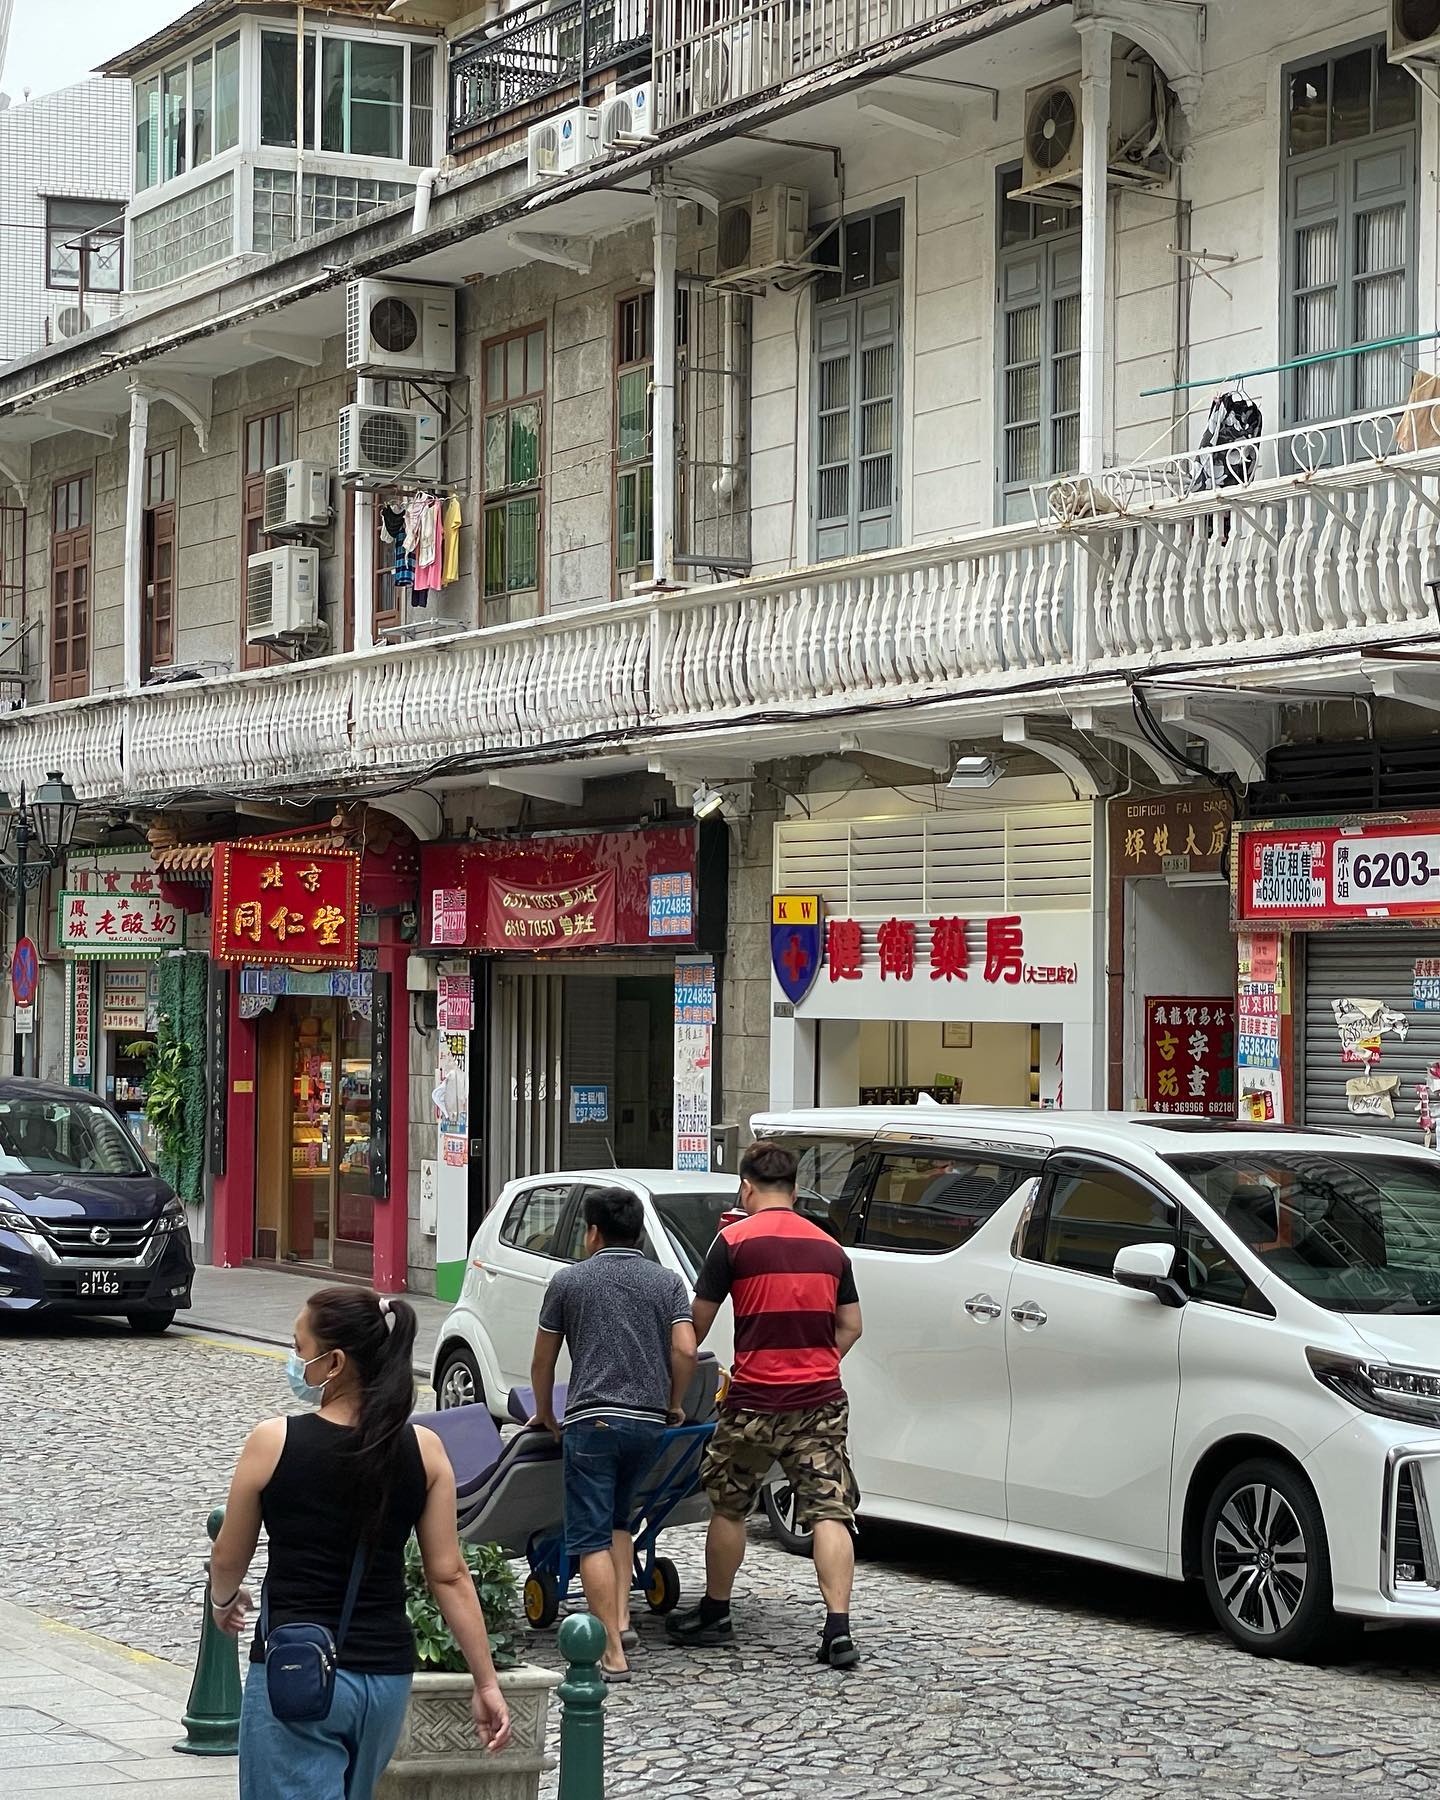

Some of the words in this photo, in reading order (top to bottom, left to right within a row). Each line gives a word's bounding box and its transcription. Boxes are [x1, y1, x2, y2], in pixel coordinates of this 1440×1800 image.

[1127, 803, 1166, 818] EDIFICIO
[1176, 801, 1192, 815] FAI
[1203, 799, 1228, 812] SANG
[260, 861, 323, 892] 北京
[1337, 847, 1350, 898] 陳小姐
[1353, 850, 1440, 889] 6203-
[530, 894, 559, 909] 1853
[1262, 877, 1311, 902] 63019096
[117, 898, 160, 911] 澳門
[651, 897, 691, 915] 62724855
[778, 902, 788, 918] K
[800, 902, 812, 918] W
[69, 899, 88, 938] 鳳城
[95, 909, 177, 936] 老酸奶
[234, 901, 346, 946] 同仁堂
[527, 919, 556, 937] 7050
[559, 912, 597, 936] 曾先生
[828, 915, 1025, 984] 健衛藥房
[1022, 962, 1078, 984] (大三巴店2)
[674, 988, 712, 1005] 62724855
[1156, 1030, 1179, 1097] 古玩
[1187, 1030, 1209, 1097] 字畫
[81, 1282, 119, 1294] 21-62
[92, 1270, 110, 1283] MY
